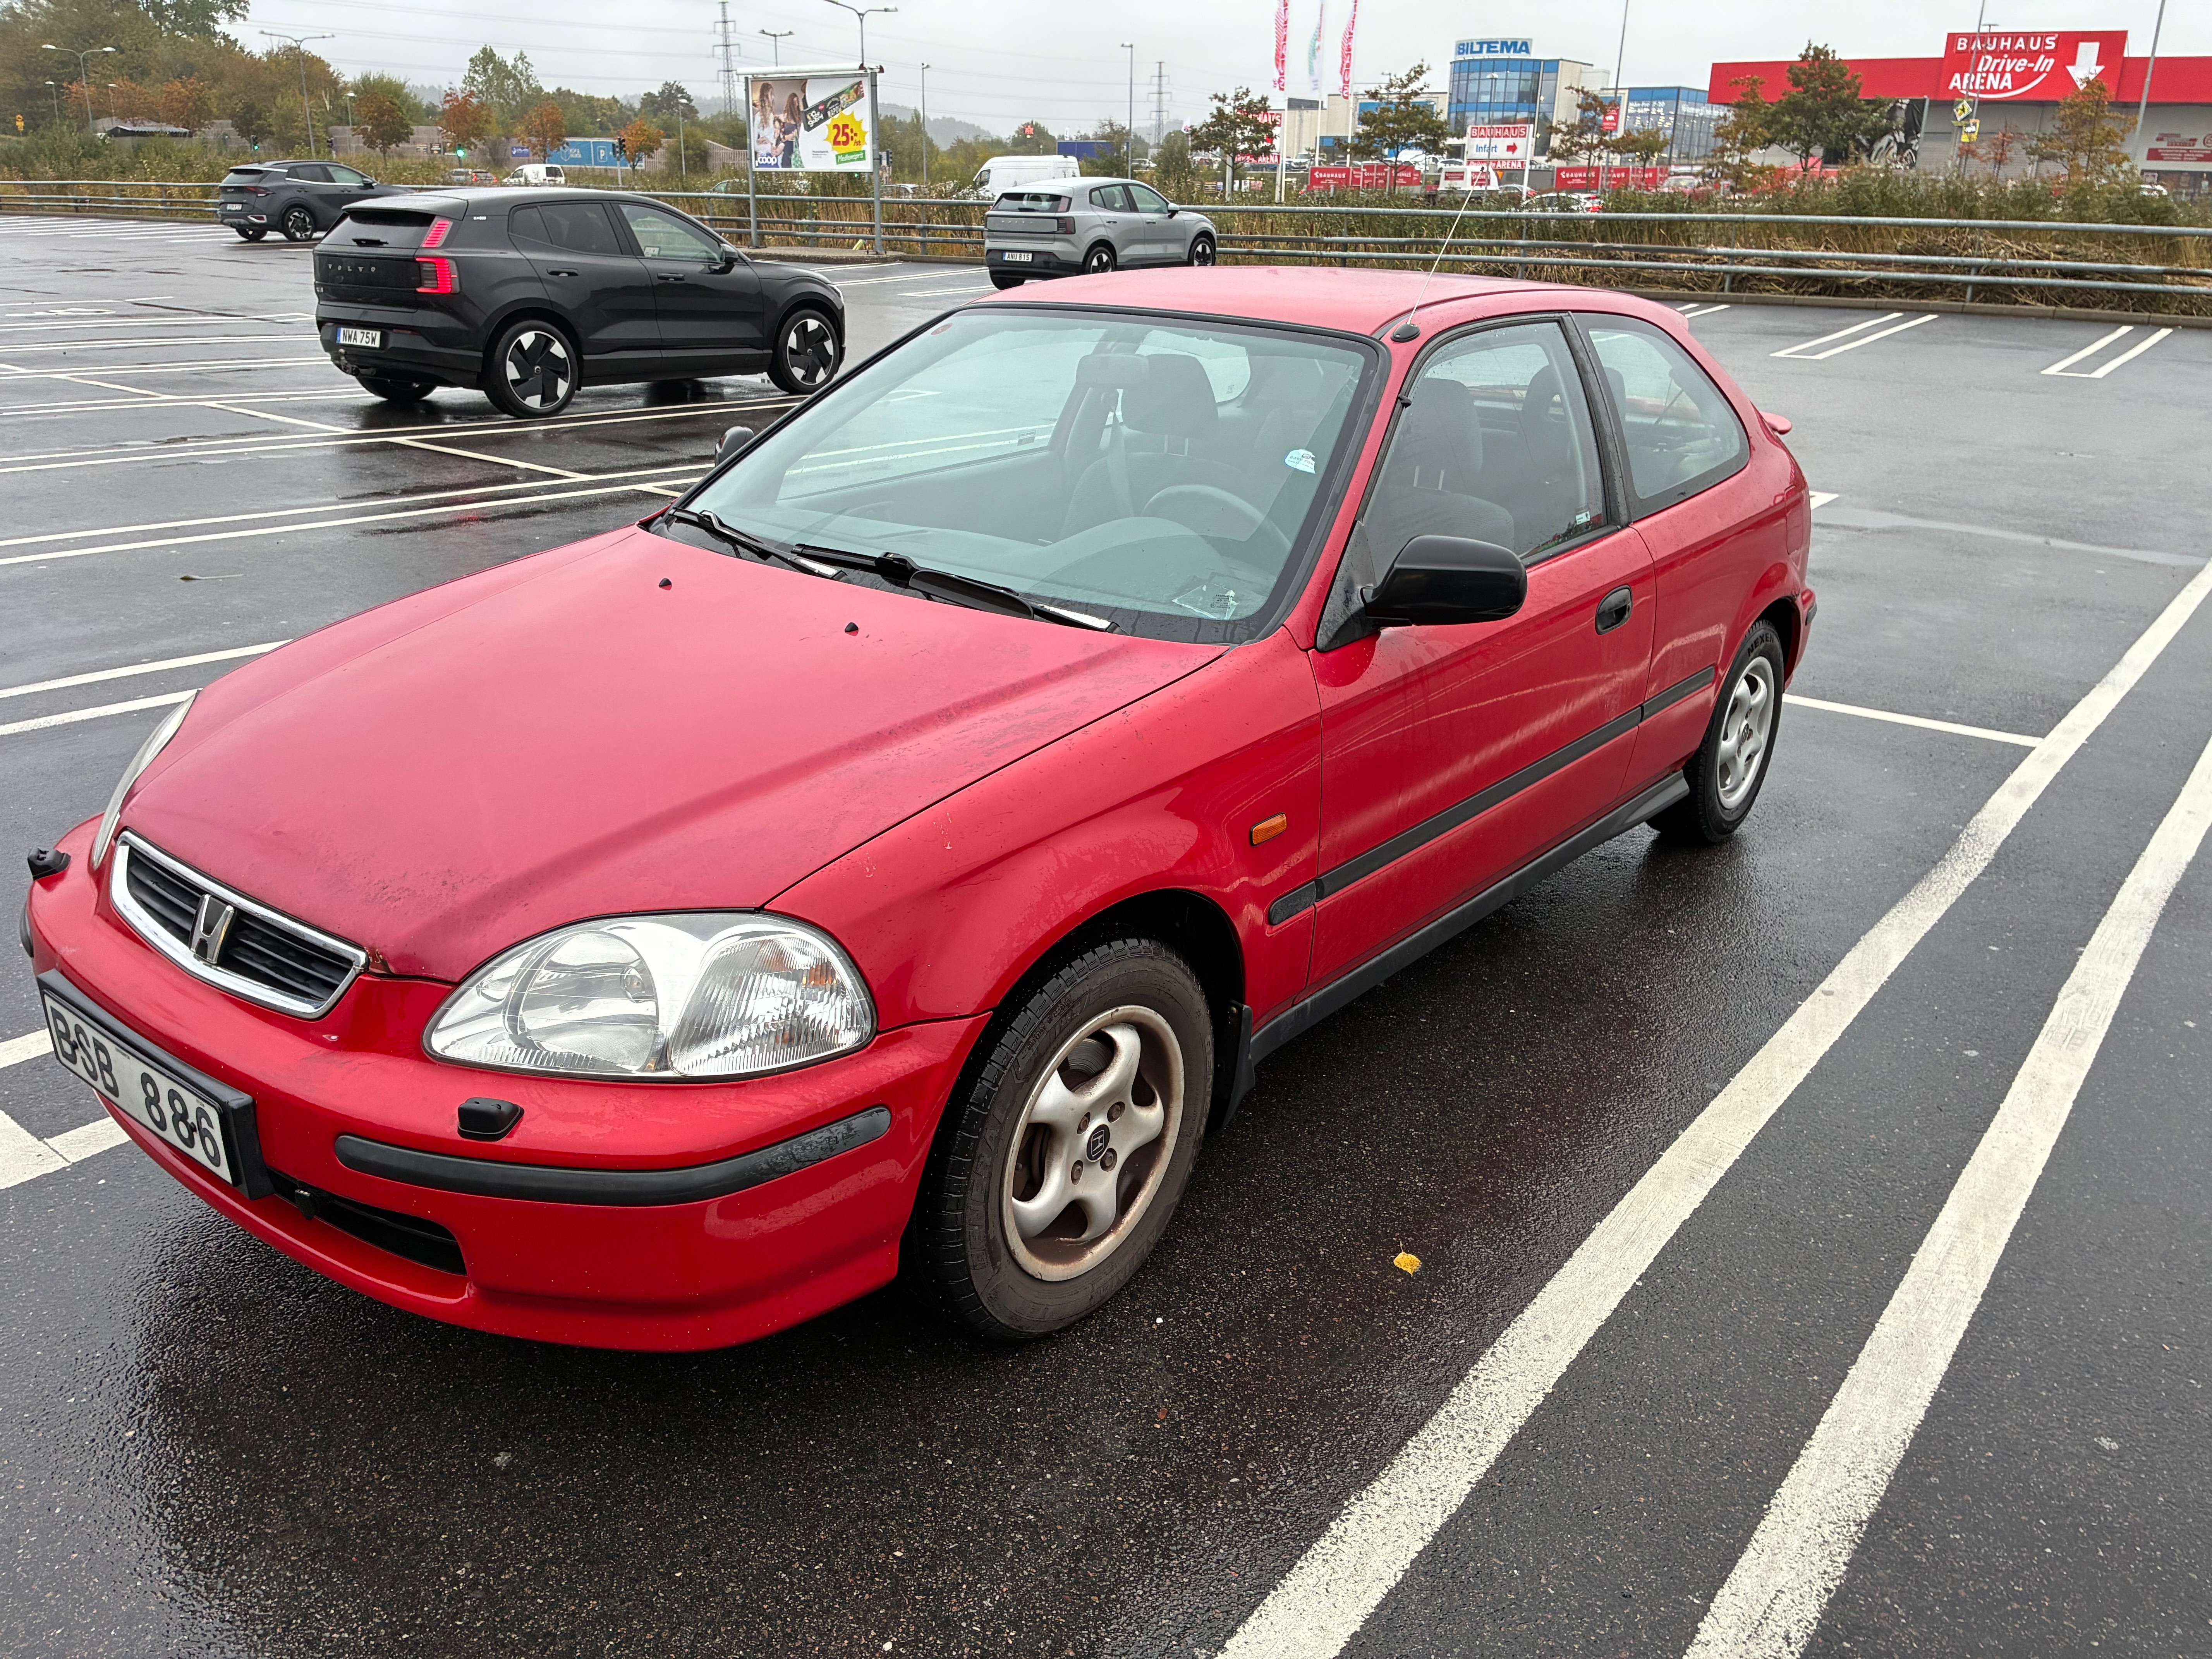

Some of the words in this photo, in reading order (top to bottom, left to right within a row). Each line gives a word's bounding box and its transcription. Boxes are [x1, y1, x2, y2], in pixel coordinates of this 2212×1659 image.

[1458, 41, 1530, 55] BILTEMA
[1957, 36, 2056, 51] BAUHAUS
[1977, 54, 2055, 72] Drive-In
[1948, 72, 2012, 90] ARENA
[1472, 127, 1526, 136] BAUHAUS
[758, 156, 777, 166] coop
[1496, 161, 1522, 169] ARENA
[343, 330, 357, 343] NWA
[360, 331, 377, 345] 75W
[1748, 632, 1774, 657] NEXEN
[50, 1005, 119, 1098] BSB
[140, 1072, 221, 1167] 886
